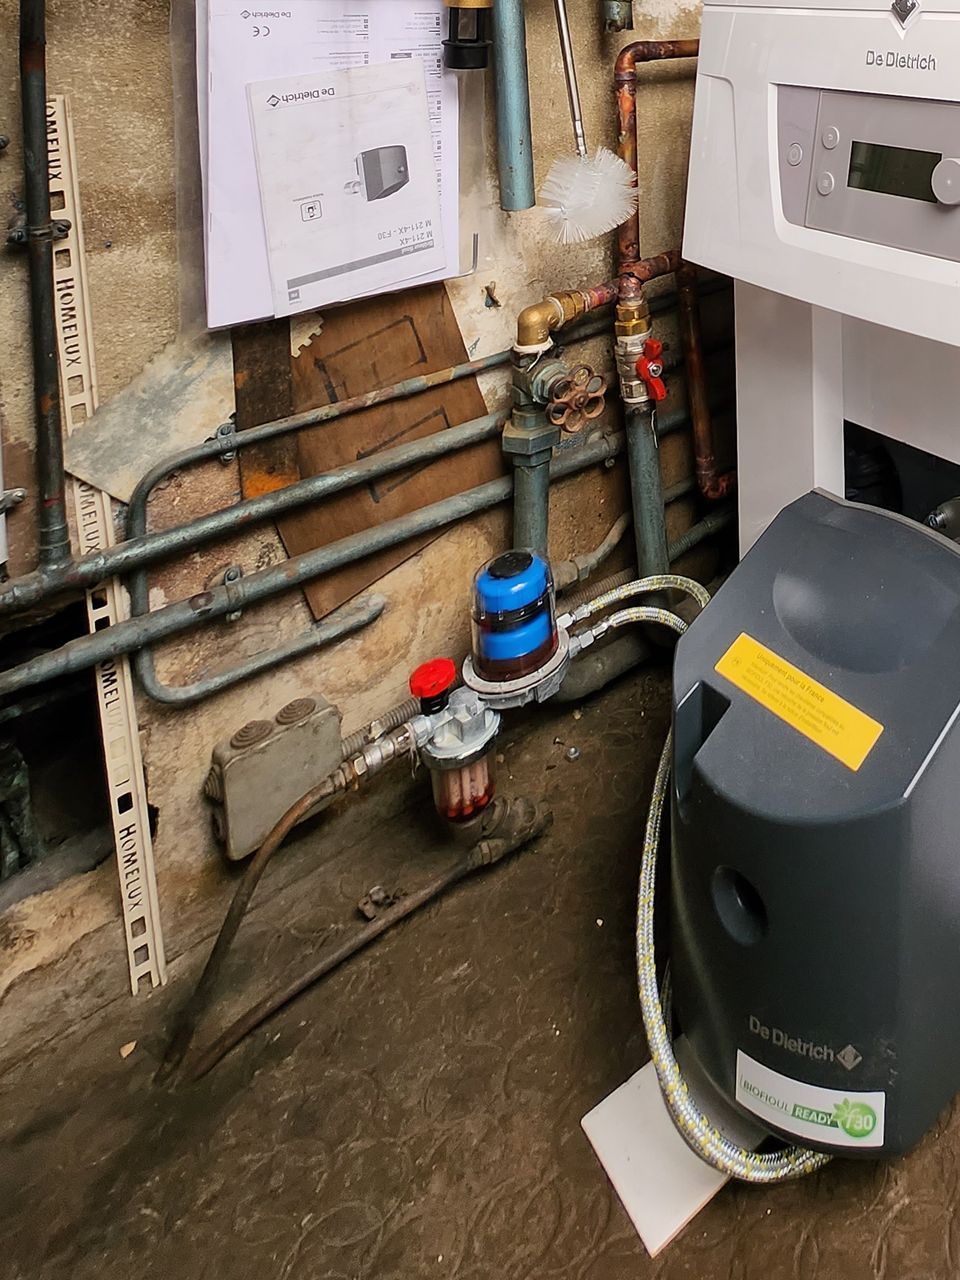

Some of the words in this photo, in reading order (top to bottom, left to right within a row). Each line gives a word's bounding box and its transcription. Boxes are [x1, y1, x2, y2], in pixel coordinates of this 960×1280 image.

[252, 11, 280, 19] Dietrich
[865, 50, 883, 66] De
[885, 51, 936, 71] Dietrich
[282, 89, 320, 103] Dietrich
[321, 87, 335, 96] De
[398, 221, 423, 234] 211-4X
[425, 219, 432, 227] M
[377, 230, 392, 241] F30
[400, 232, 425, 246] 211-4X
[426, 230, 433, 238] M
[56, 277, 82, 368] HOMELUX
[79, 482, 101, 554] OMELUX
[806, 685, 825, 704] France
[119, 823, 143, 912] HOMELUX
[749, 1014, 770, 1040] De
[772, 1027, 834, 1062] Dietrich
[743, 1079, 790, 1113] BIOFIOUL
[795, 1106, 833, 1126] READY
